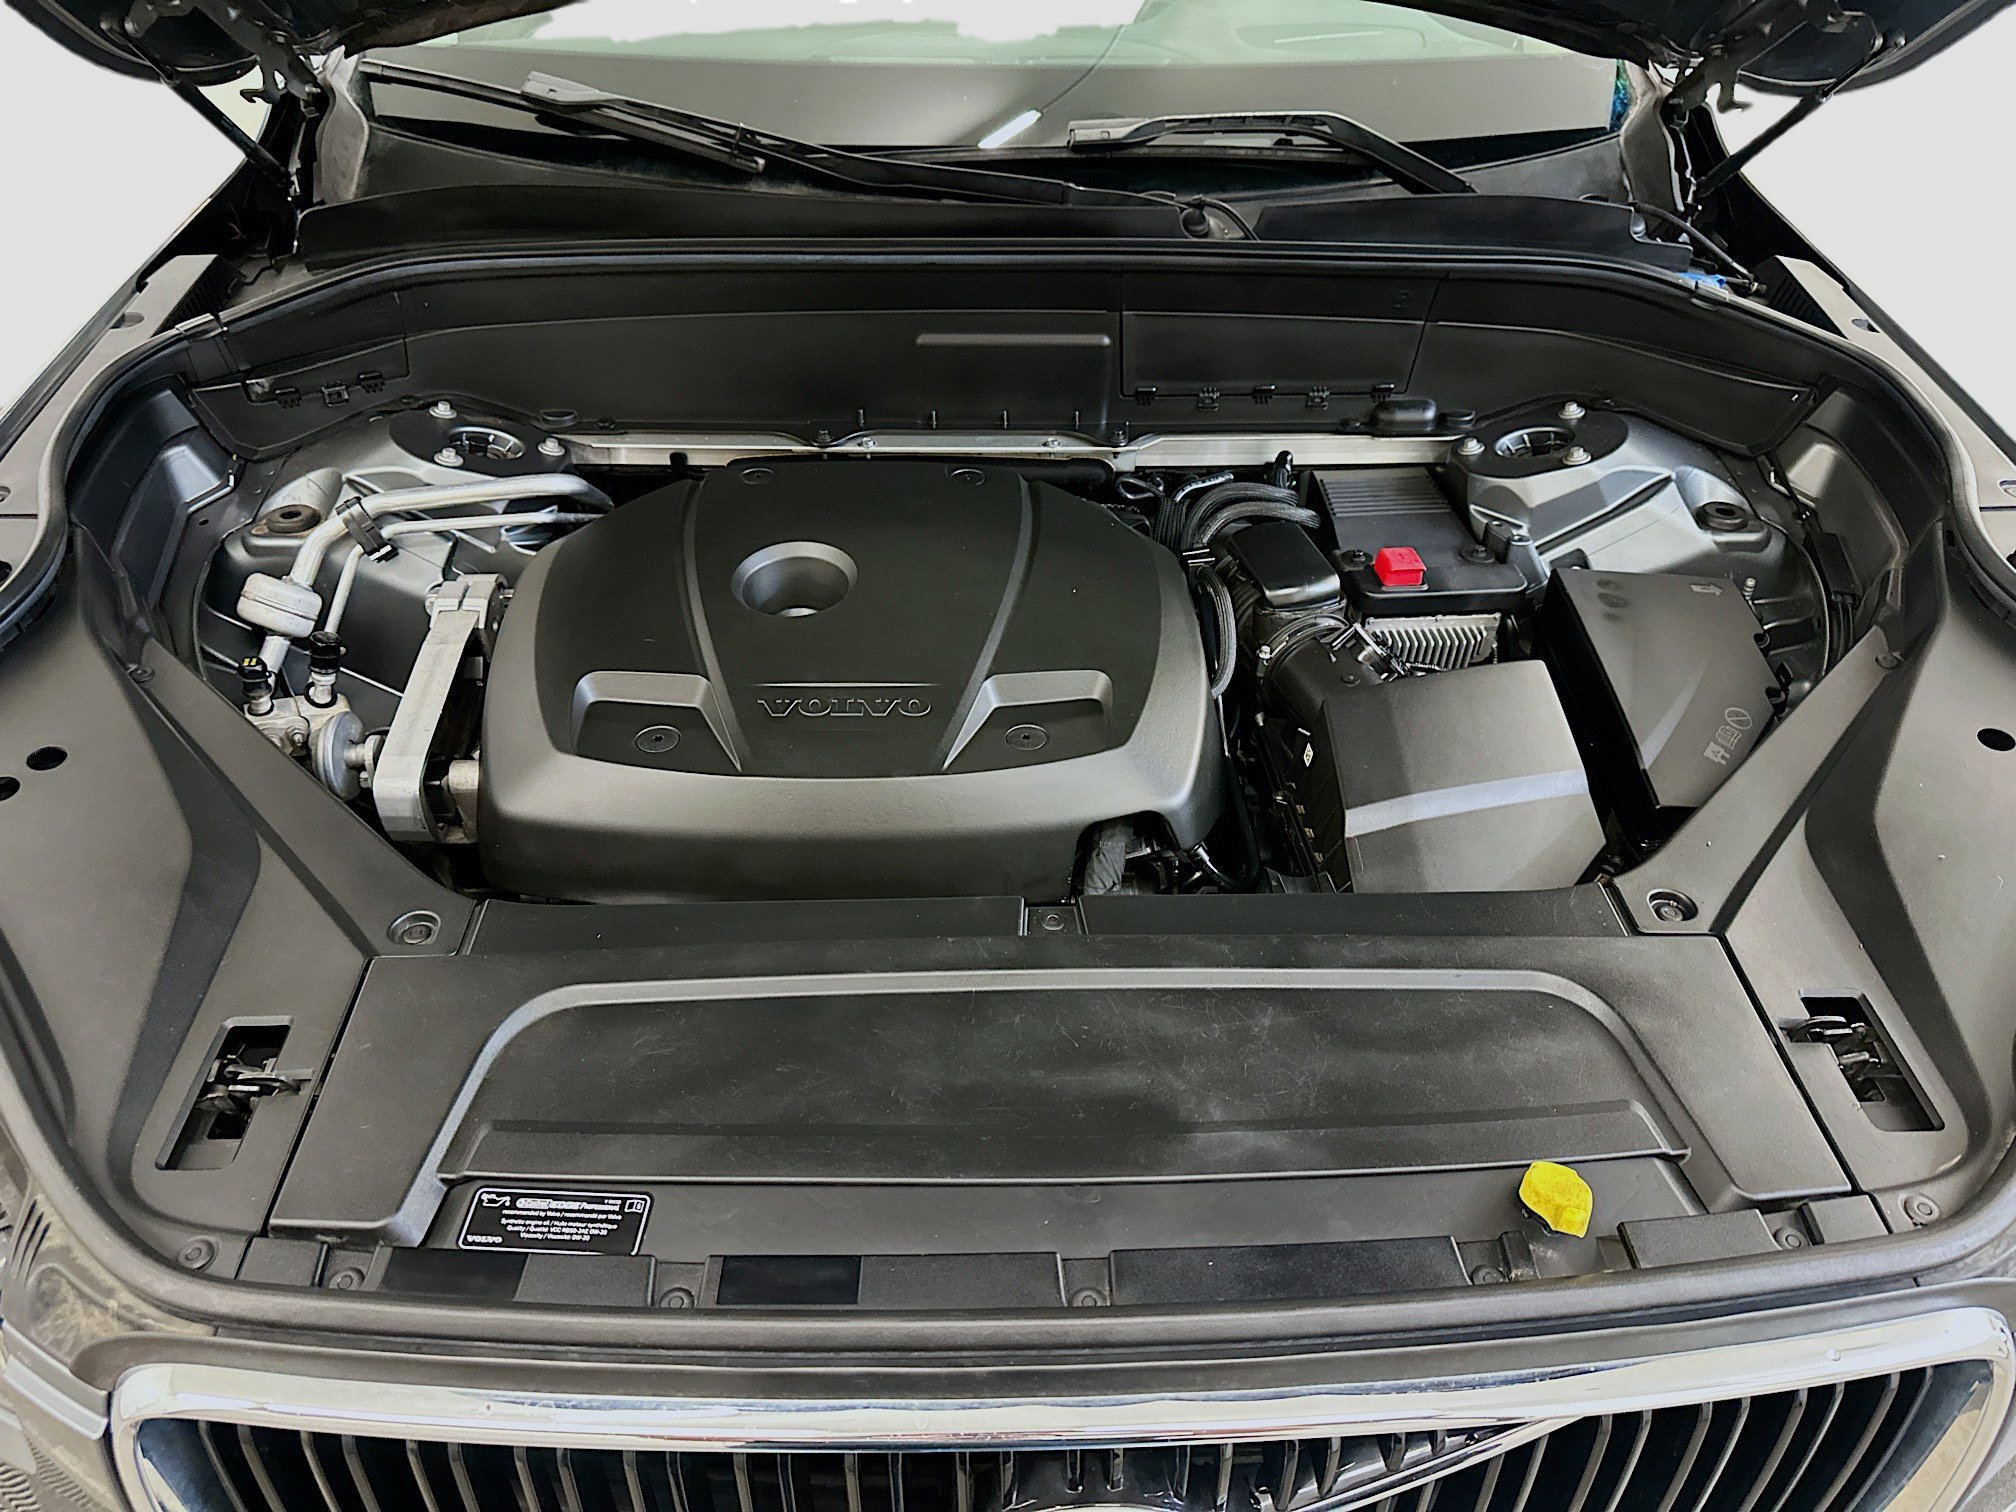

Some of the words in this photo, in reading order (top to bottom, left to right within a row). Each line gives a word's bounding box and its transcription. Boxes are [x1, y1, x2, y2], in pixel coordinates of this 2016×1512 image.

[757, 698, 932, 717] VOLVO
[467, 1234, 503, 1243] VOLVO
[520, 1232, 544, 1240] Viscosity
